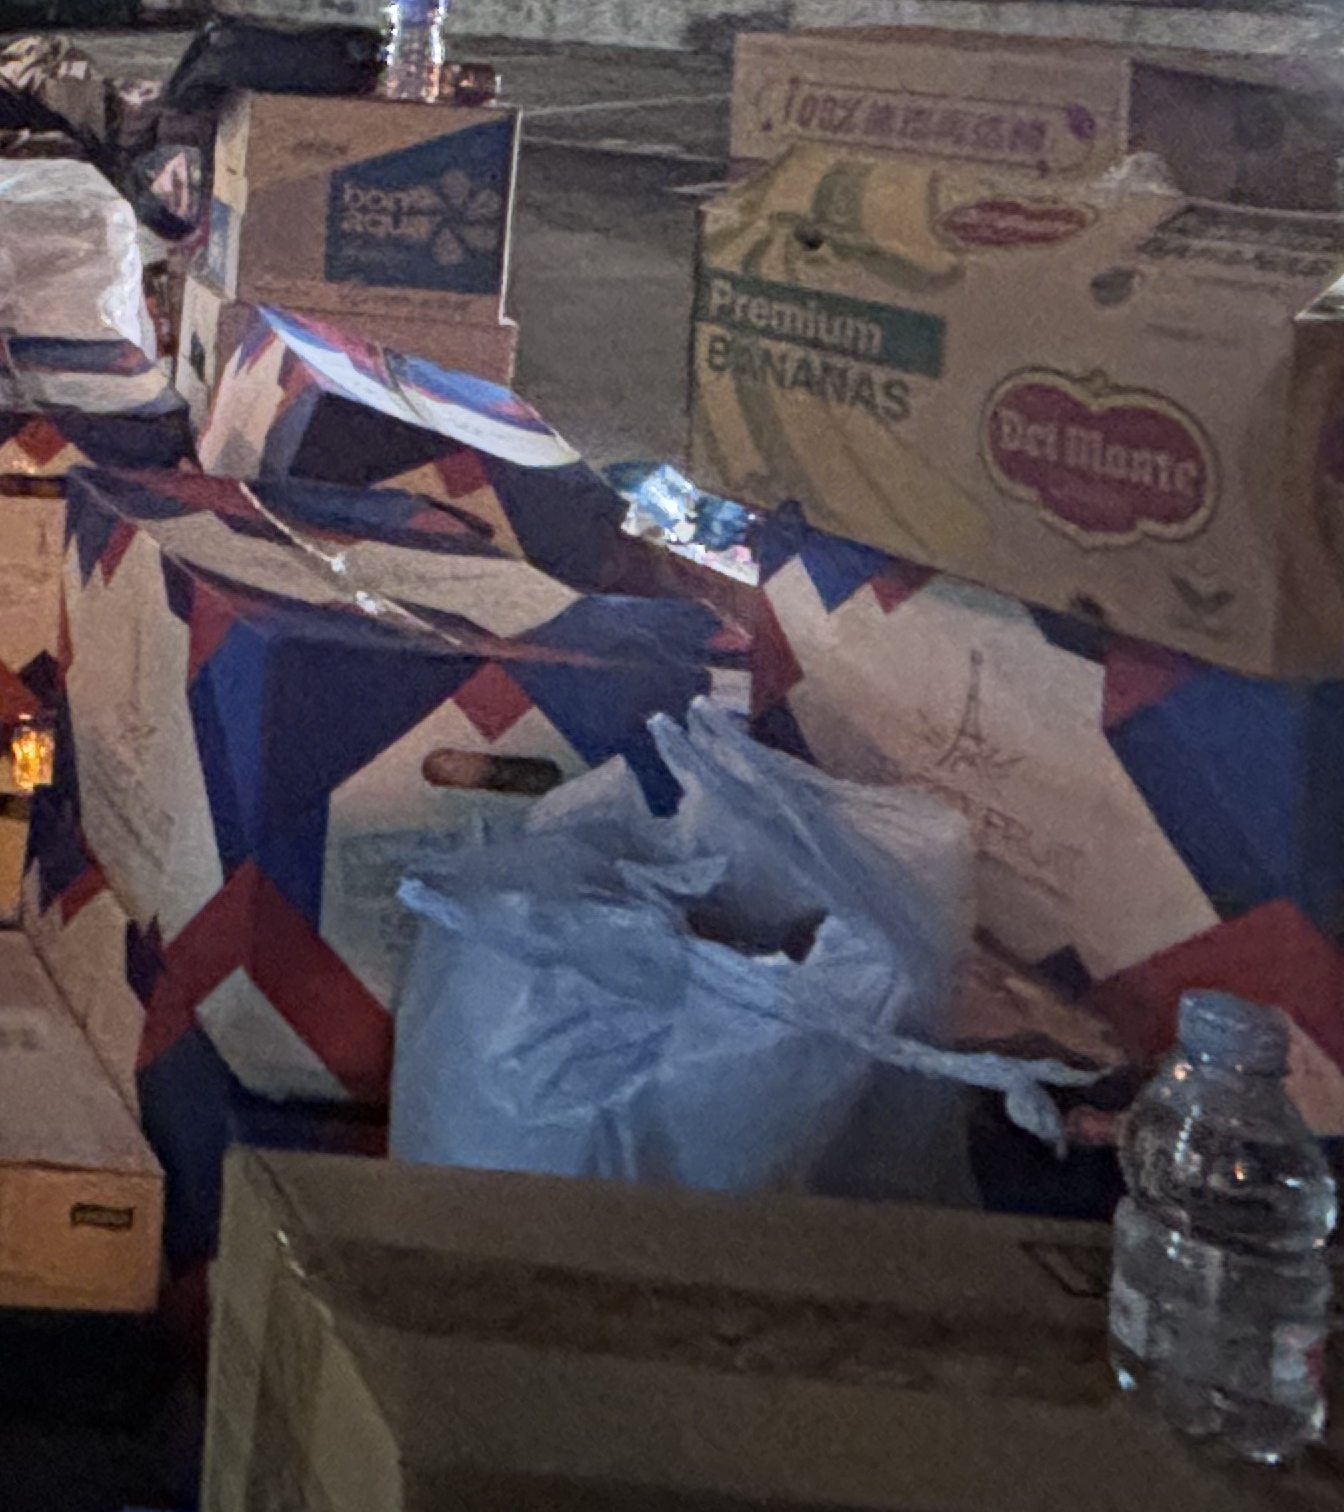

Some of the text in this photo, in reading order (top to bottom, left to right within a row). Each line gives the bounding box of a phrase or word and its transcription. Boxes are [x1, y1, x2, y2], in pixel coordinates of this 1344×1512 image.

[706, 278, 882, 356] Premium
[704, 331, 912, 421] BANANAS
[997, 407, 1199, 494] Del Monte
